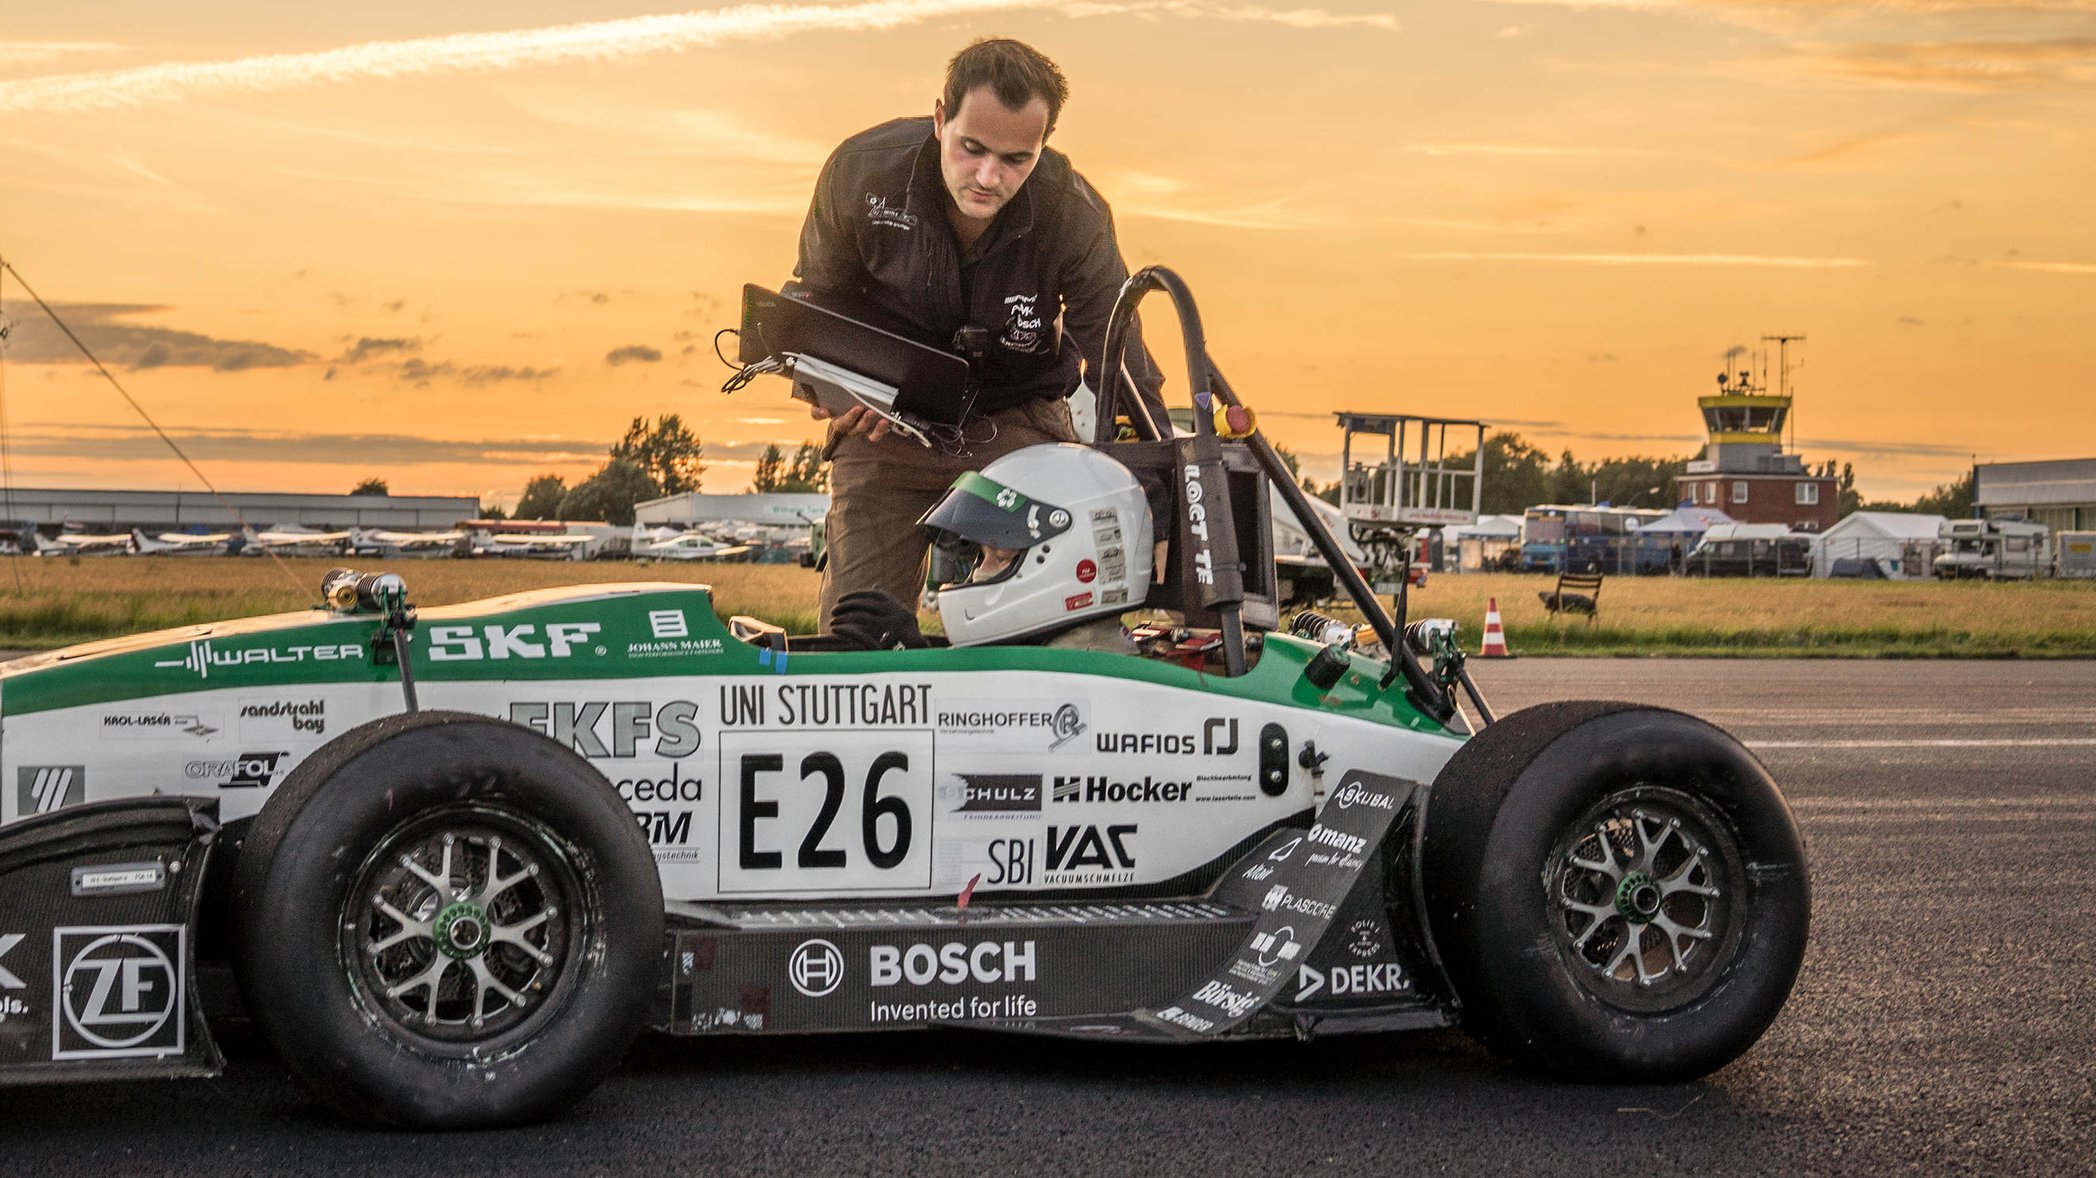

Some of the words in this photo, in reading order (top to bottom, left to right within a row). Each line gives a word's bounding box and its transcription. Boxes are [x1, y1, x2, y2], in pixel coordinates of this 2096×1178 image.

[213, 644, 364, 666] WALTER
[628, 642, 678, 653] JOHANN
[240, 700, 325, 727] sandstrahl
[720, 685, 765, 726] UNI
[777, 684, 932, 725] STUTTGART
[293, 716, 325, 734] bay
[938, 712, 1053, 728] RINGHOFFER
[1097, 733, 1196, 755] WAFIOS
[185, 758, 273, 778] ORAFOL
[963, 787, 1036, 801] CHULZ
[1085, 776, 1193, 803] Hocker
[739, 751, 913, 870] E26
[1045, 824, 1138, 871] VAC
[1318, 827, 1368, 855] manz
[987, 838, 1035, 885] SBI
[1242, 862, 1275, 882] Altair
[1044, 872, 1136, 884] VACUUMSCHMELZE
[1280, 895, 1338, 920] PLASCORE
[870, 940, 1037, 987] BOSCH
[64, 957, 166, 1025] ZF
[1331, 963, 1411, 995] DEKR
[870, 997, 965, 1022] Invented
[970, 995, 1001, 1019] for
[1005, 994, 1037, 1017] life
